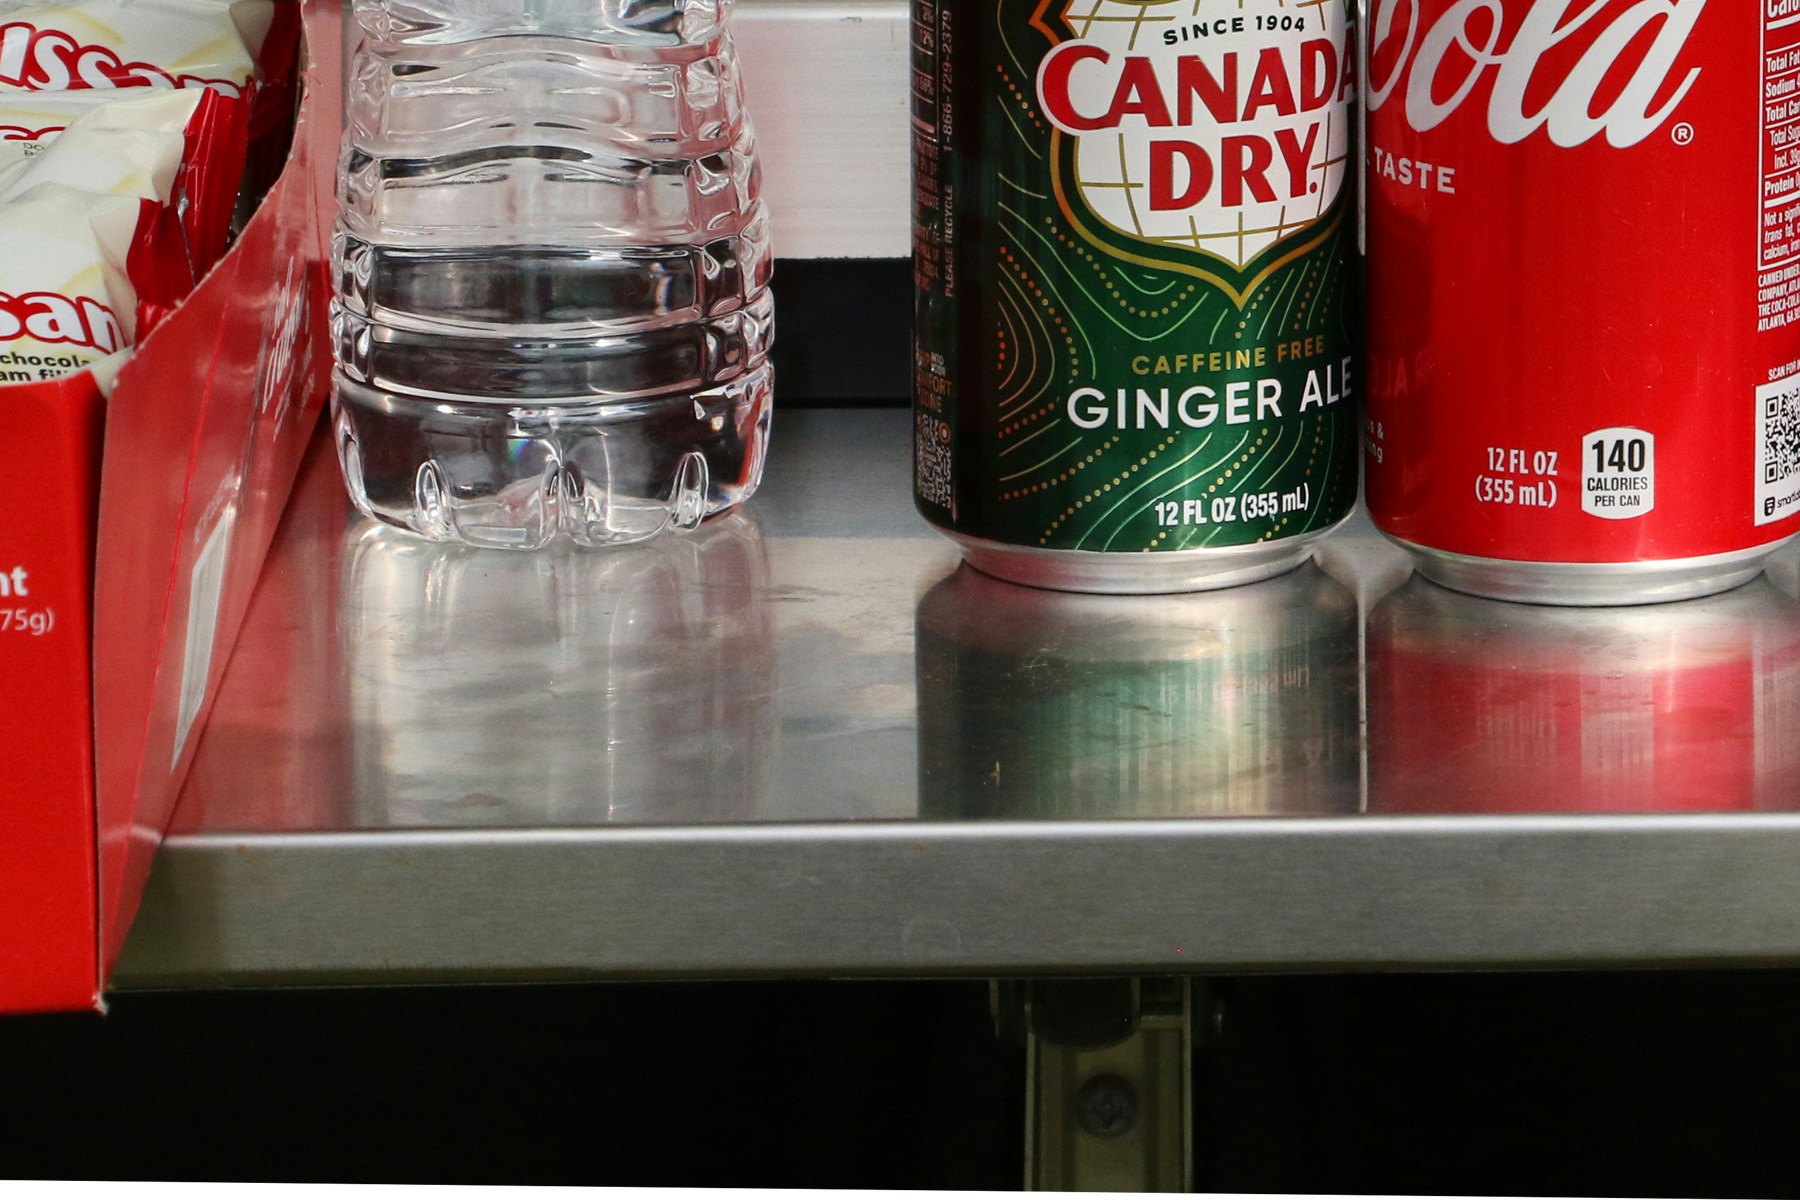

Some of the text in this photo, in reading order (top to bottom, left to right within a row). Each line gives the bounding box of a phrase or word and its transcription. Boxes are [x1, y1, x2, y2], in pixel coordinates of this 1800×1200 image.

[1162, 15, 1306, 46] SINCE 1904
[1766, 50, 1800, 73] Total Fat
[1766, 78, 1796, 98] Sodium
[1149, 122, 1320, 211] DRY.
[1373, 146, 1456, 194] TASTE
[1765, 178, 1795, 197] Protein
[944, 186, 953, 297] PLEASE RECYCLE
[1131, 336, 1324, 375] CAFFEINE FREE
[1067, 356, 1352, 429] GINGER ALE
[1487, 447, 1558, 476] 12 FL OZ
[1592, 439, 1646, 473] 140
[1474, 475, 1557, 509] (355 mL)
[1586, 477, 1648, 492] CALORIES
[1594, 494, 1640, 508] PER CAN
[1155, 482, 1310, 526] 12 FL OZ (355 mL)
